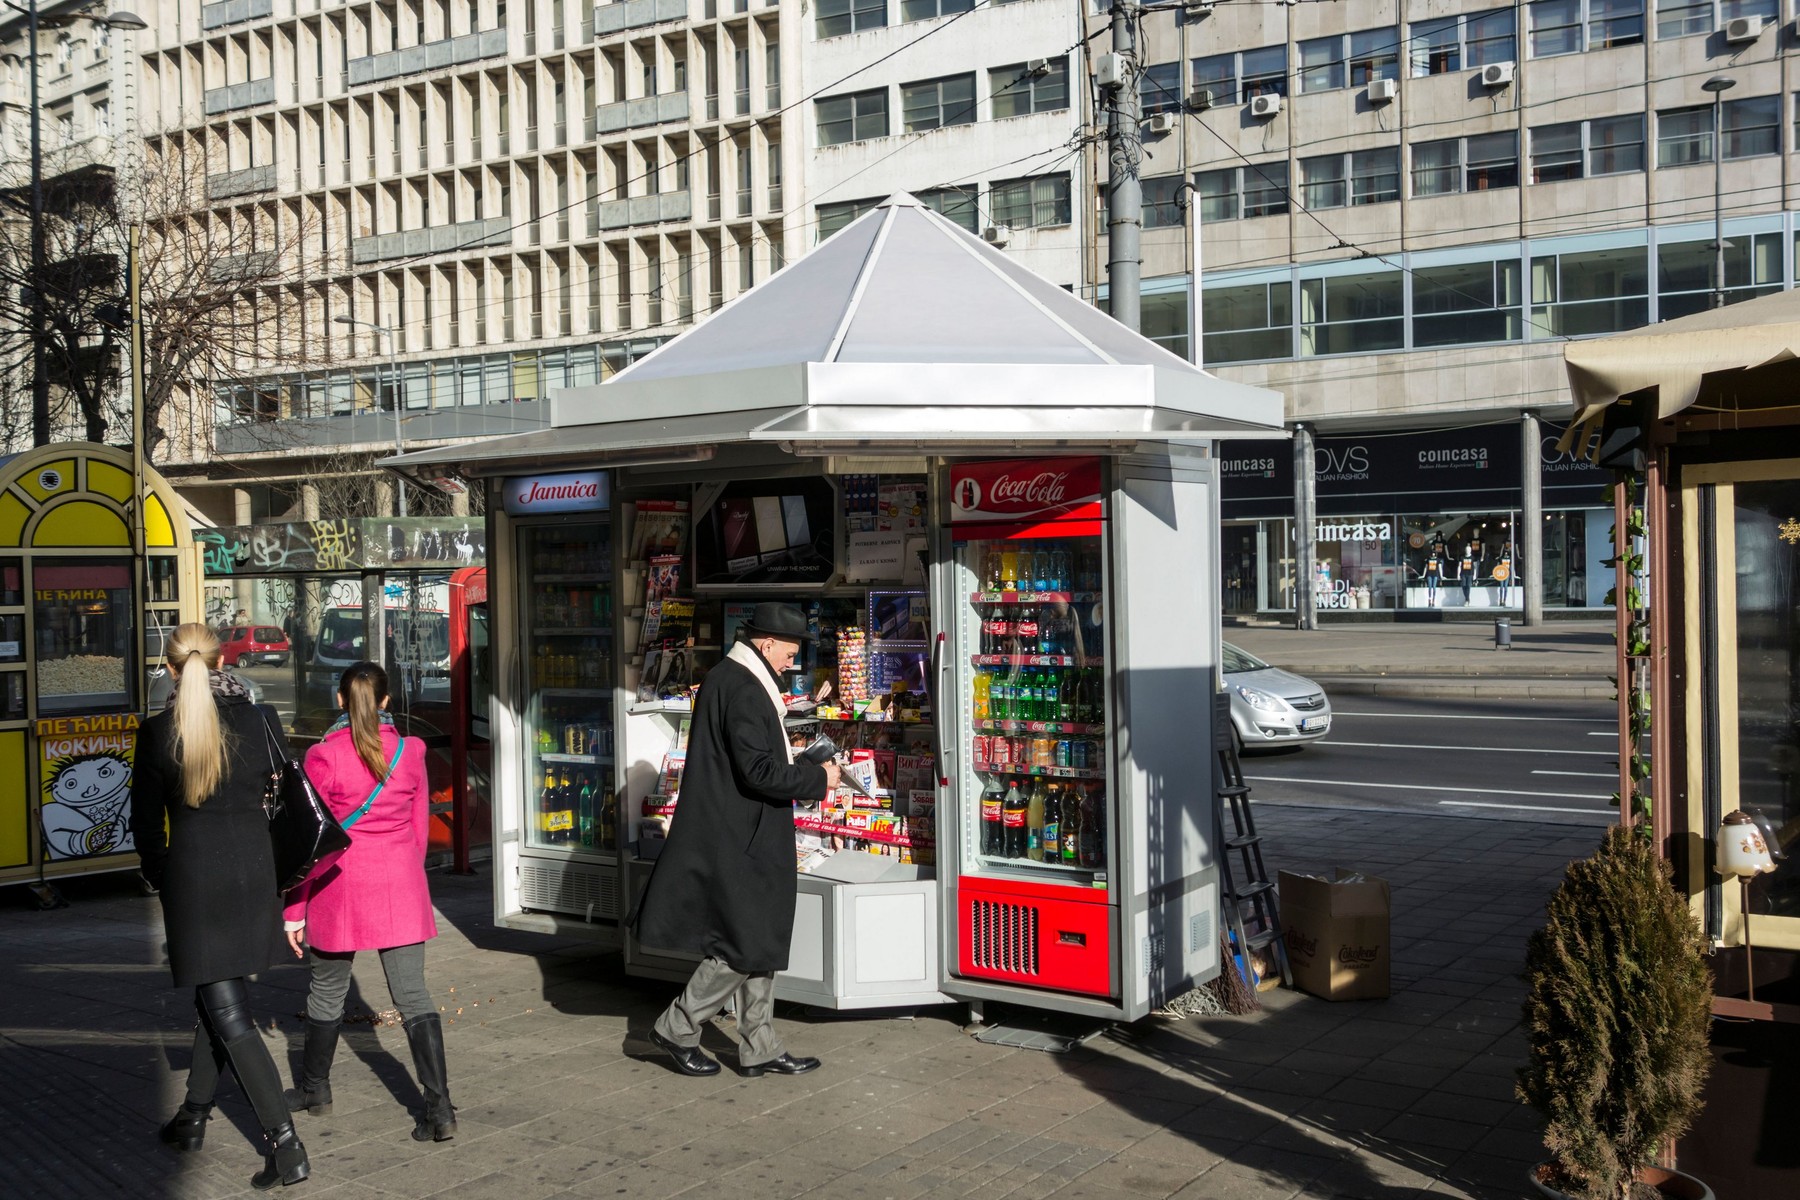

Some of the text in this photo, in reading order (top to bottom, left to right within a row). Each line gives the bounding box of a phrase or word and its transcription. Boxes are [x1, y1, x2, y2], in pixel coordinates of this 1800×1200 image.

[1221, 458, 1275, 472] oincasa
[1315, 446, 1369, 474] OVS
[1418, 447, 1488, 463] coincasa
[1542, 464, 1569, 472] TALIAN
[518, 480, 598, 504] Jamnica
[990, 472, 1069, 504] Coca-Cola
[1292, 521, 1391, 541] incasa
[1364, 541, 1377, 550] 50
[36, 714, 140, 736] ПЕЋИНА
[45, 731, 132, 760] КОКИЦЕ
[846, 816, 866, 826] Puls
